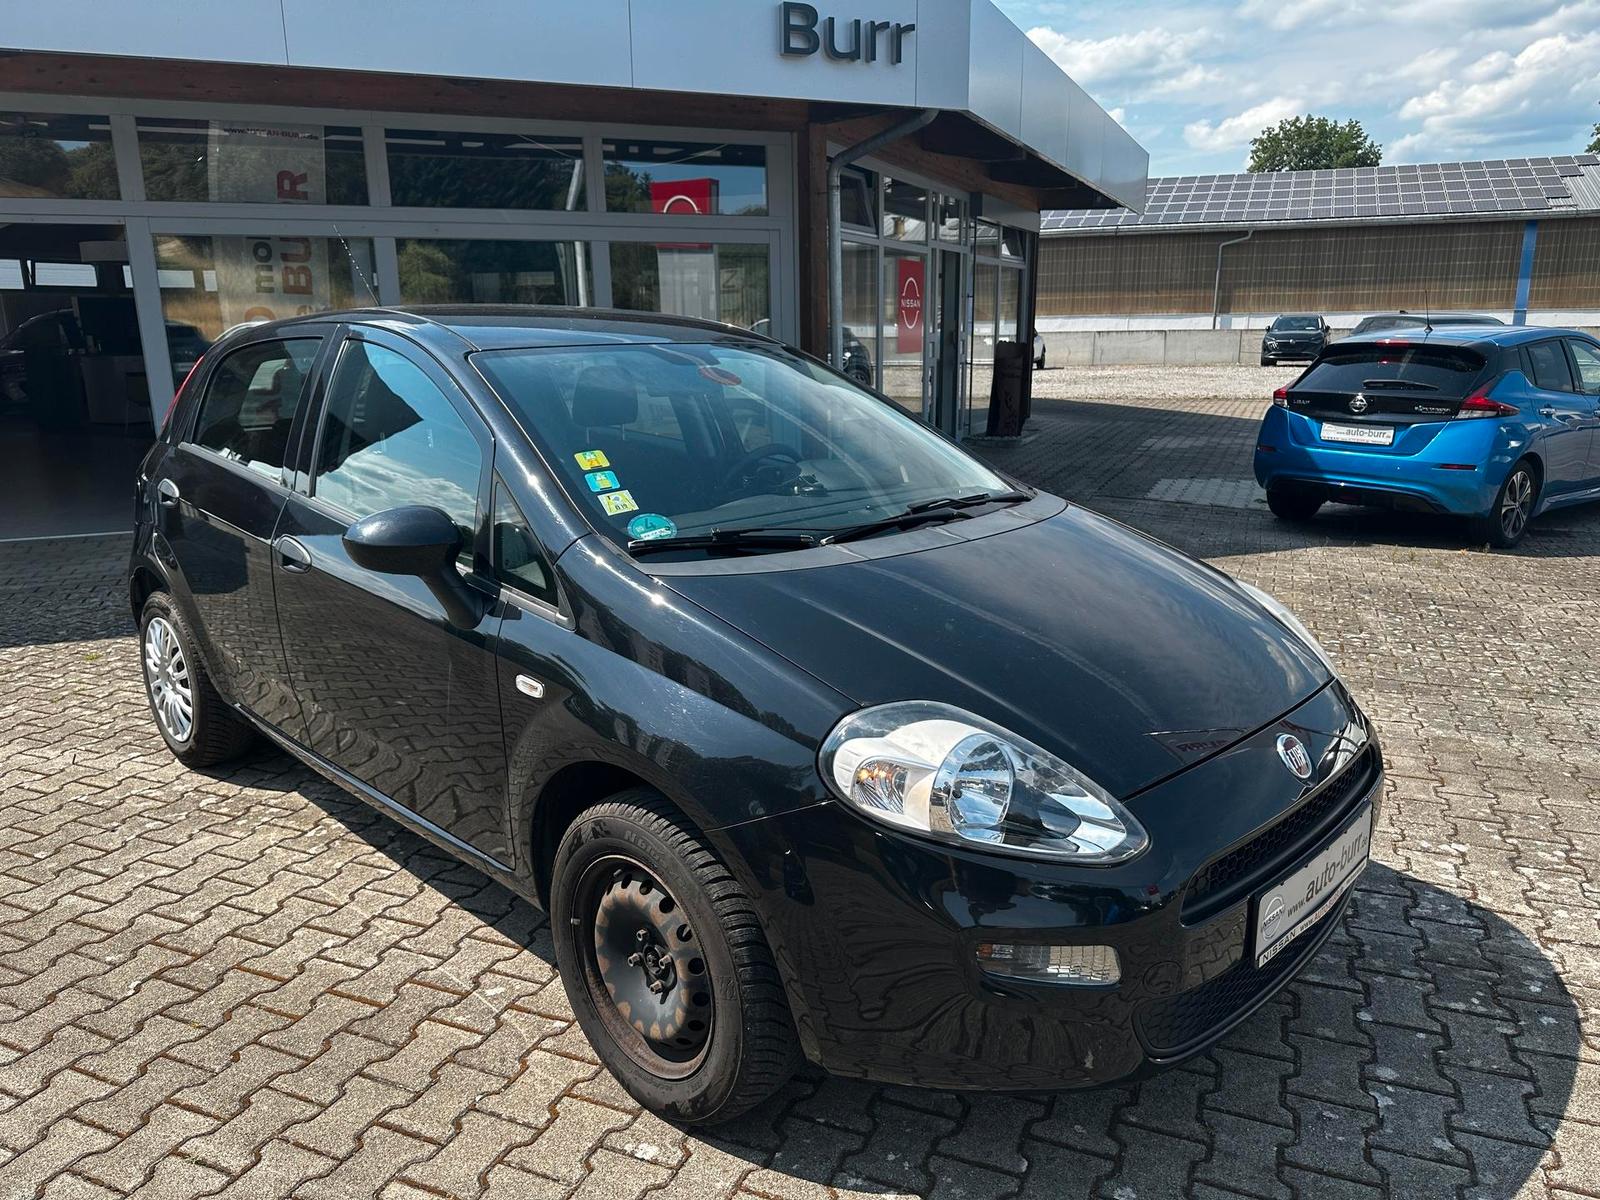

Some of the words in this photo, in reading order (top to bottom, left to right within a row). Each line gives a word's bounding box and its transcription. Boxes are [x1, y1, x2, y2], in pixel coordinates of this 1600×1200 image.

[779, 1, 916, 64] Burr
[277, 170, 313, 295] BUR
[900, 298, 921, 309] NISSAN
[1261, 906, 1285, 928] NISSAN
[1262, 929, 1297, 963] NISSAN
